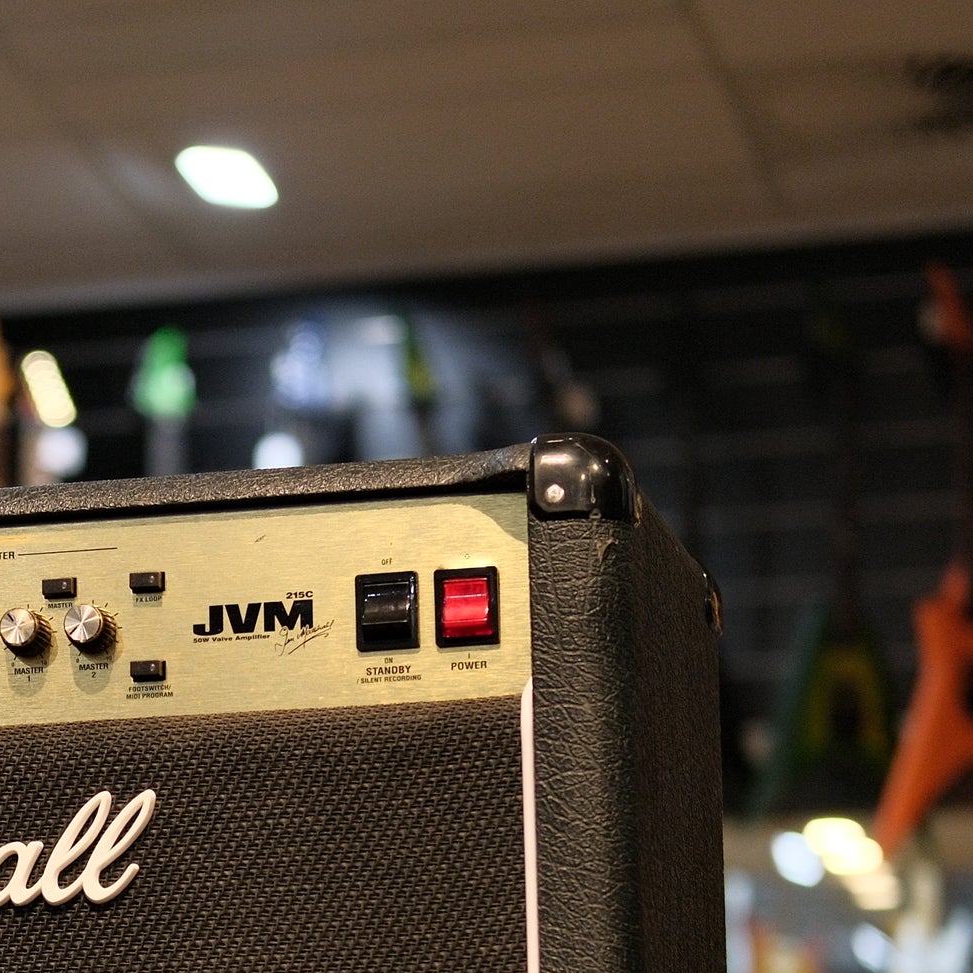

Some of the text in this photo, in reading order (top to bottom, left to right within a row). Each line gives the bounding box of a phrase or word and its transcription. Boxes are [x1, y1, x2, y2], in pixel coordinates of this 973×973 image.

[381, 557, 393, 566] OFF
[286, 590, 314, 600] 215C
[192, 599, 314, 636] JVM
[235, 634, 270, 642] Amplifier
[78, 663, 109, 671] MASTER
[366, 665, 412, 676] STANDBY
[450, 660, 488, 671] POWER
[13, 667, 44, 676] MASTER
[360, 676, 383, 684] SILENT
[384, 674, 422, 682] RECORDING
